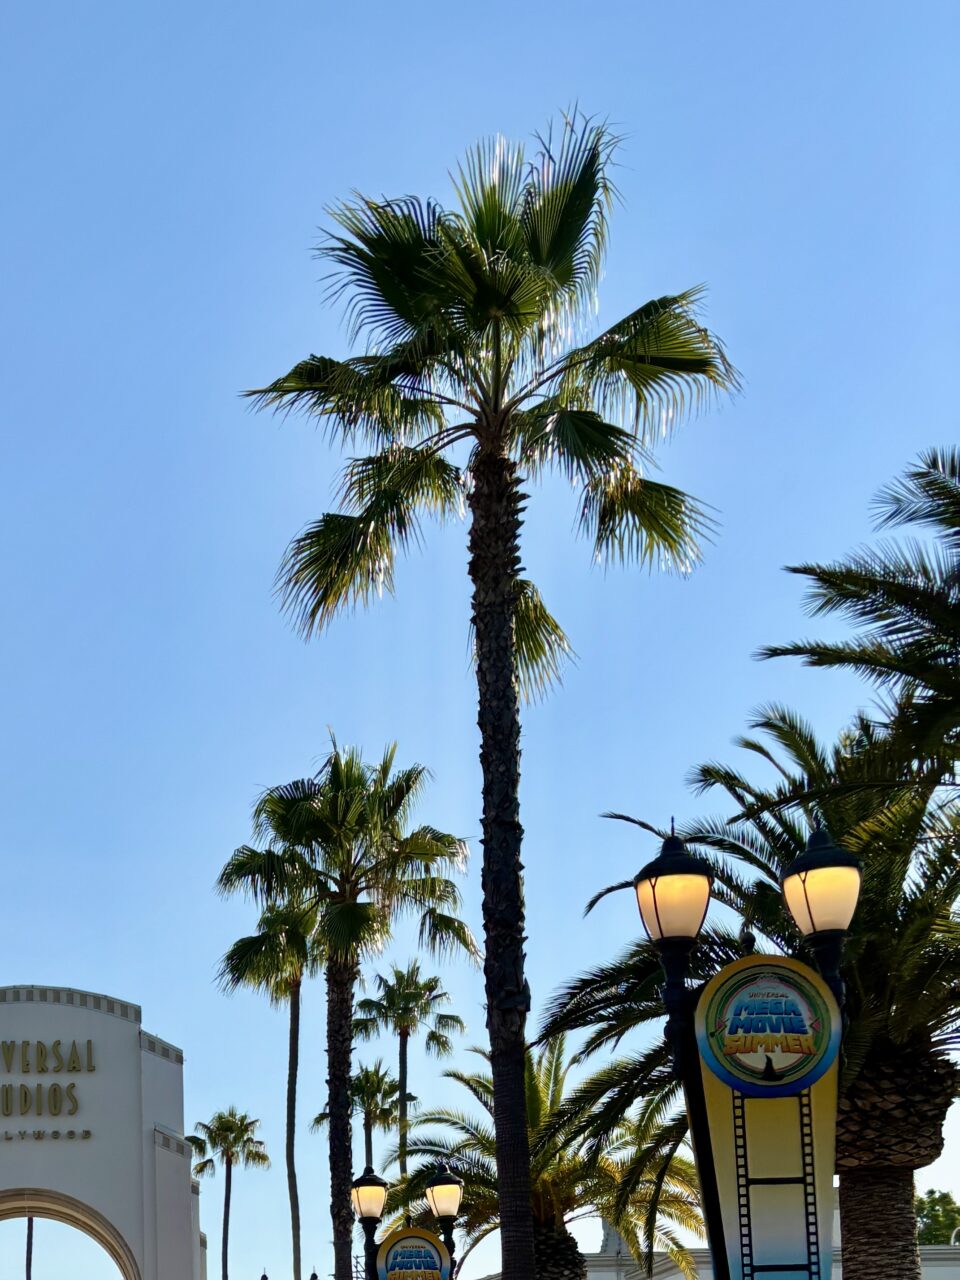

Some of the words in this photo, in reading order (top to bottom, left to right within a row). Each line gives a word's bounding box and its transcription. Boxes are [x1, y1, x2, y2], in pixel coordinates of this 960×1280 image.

[733, 999, 802, 1016] MEGA
[727, 1016, 809, 1035] MOVIE
[723, 1034, 817, 1056] SUMMER
[393, 1249, 434, 1260] MEGA
[389, 1259, 438, 1271] MOVIE
